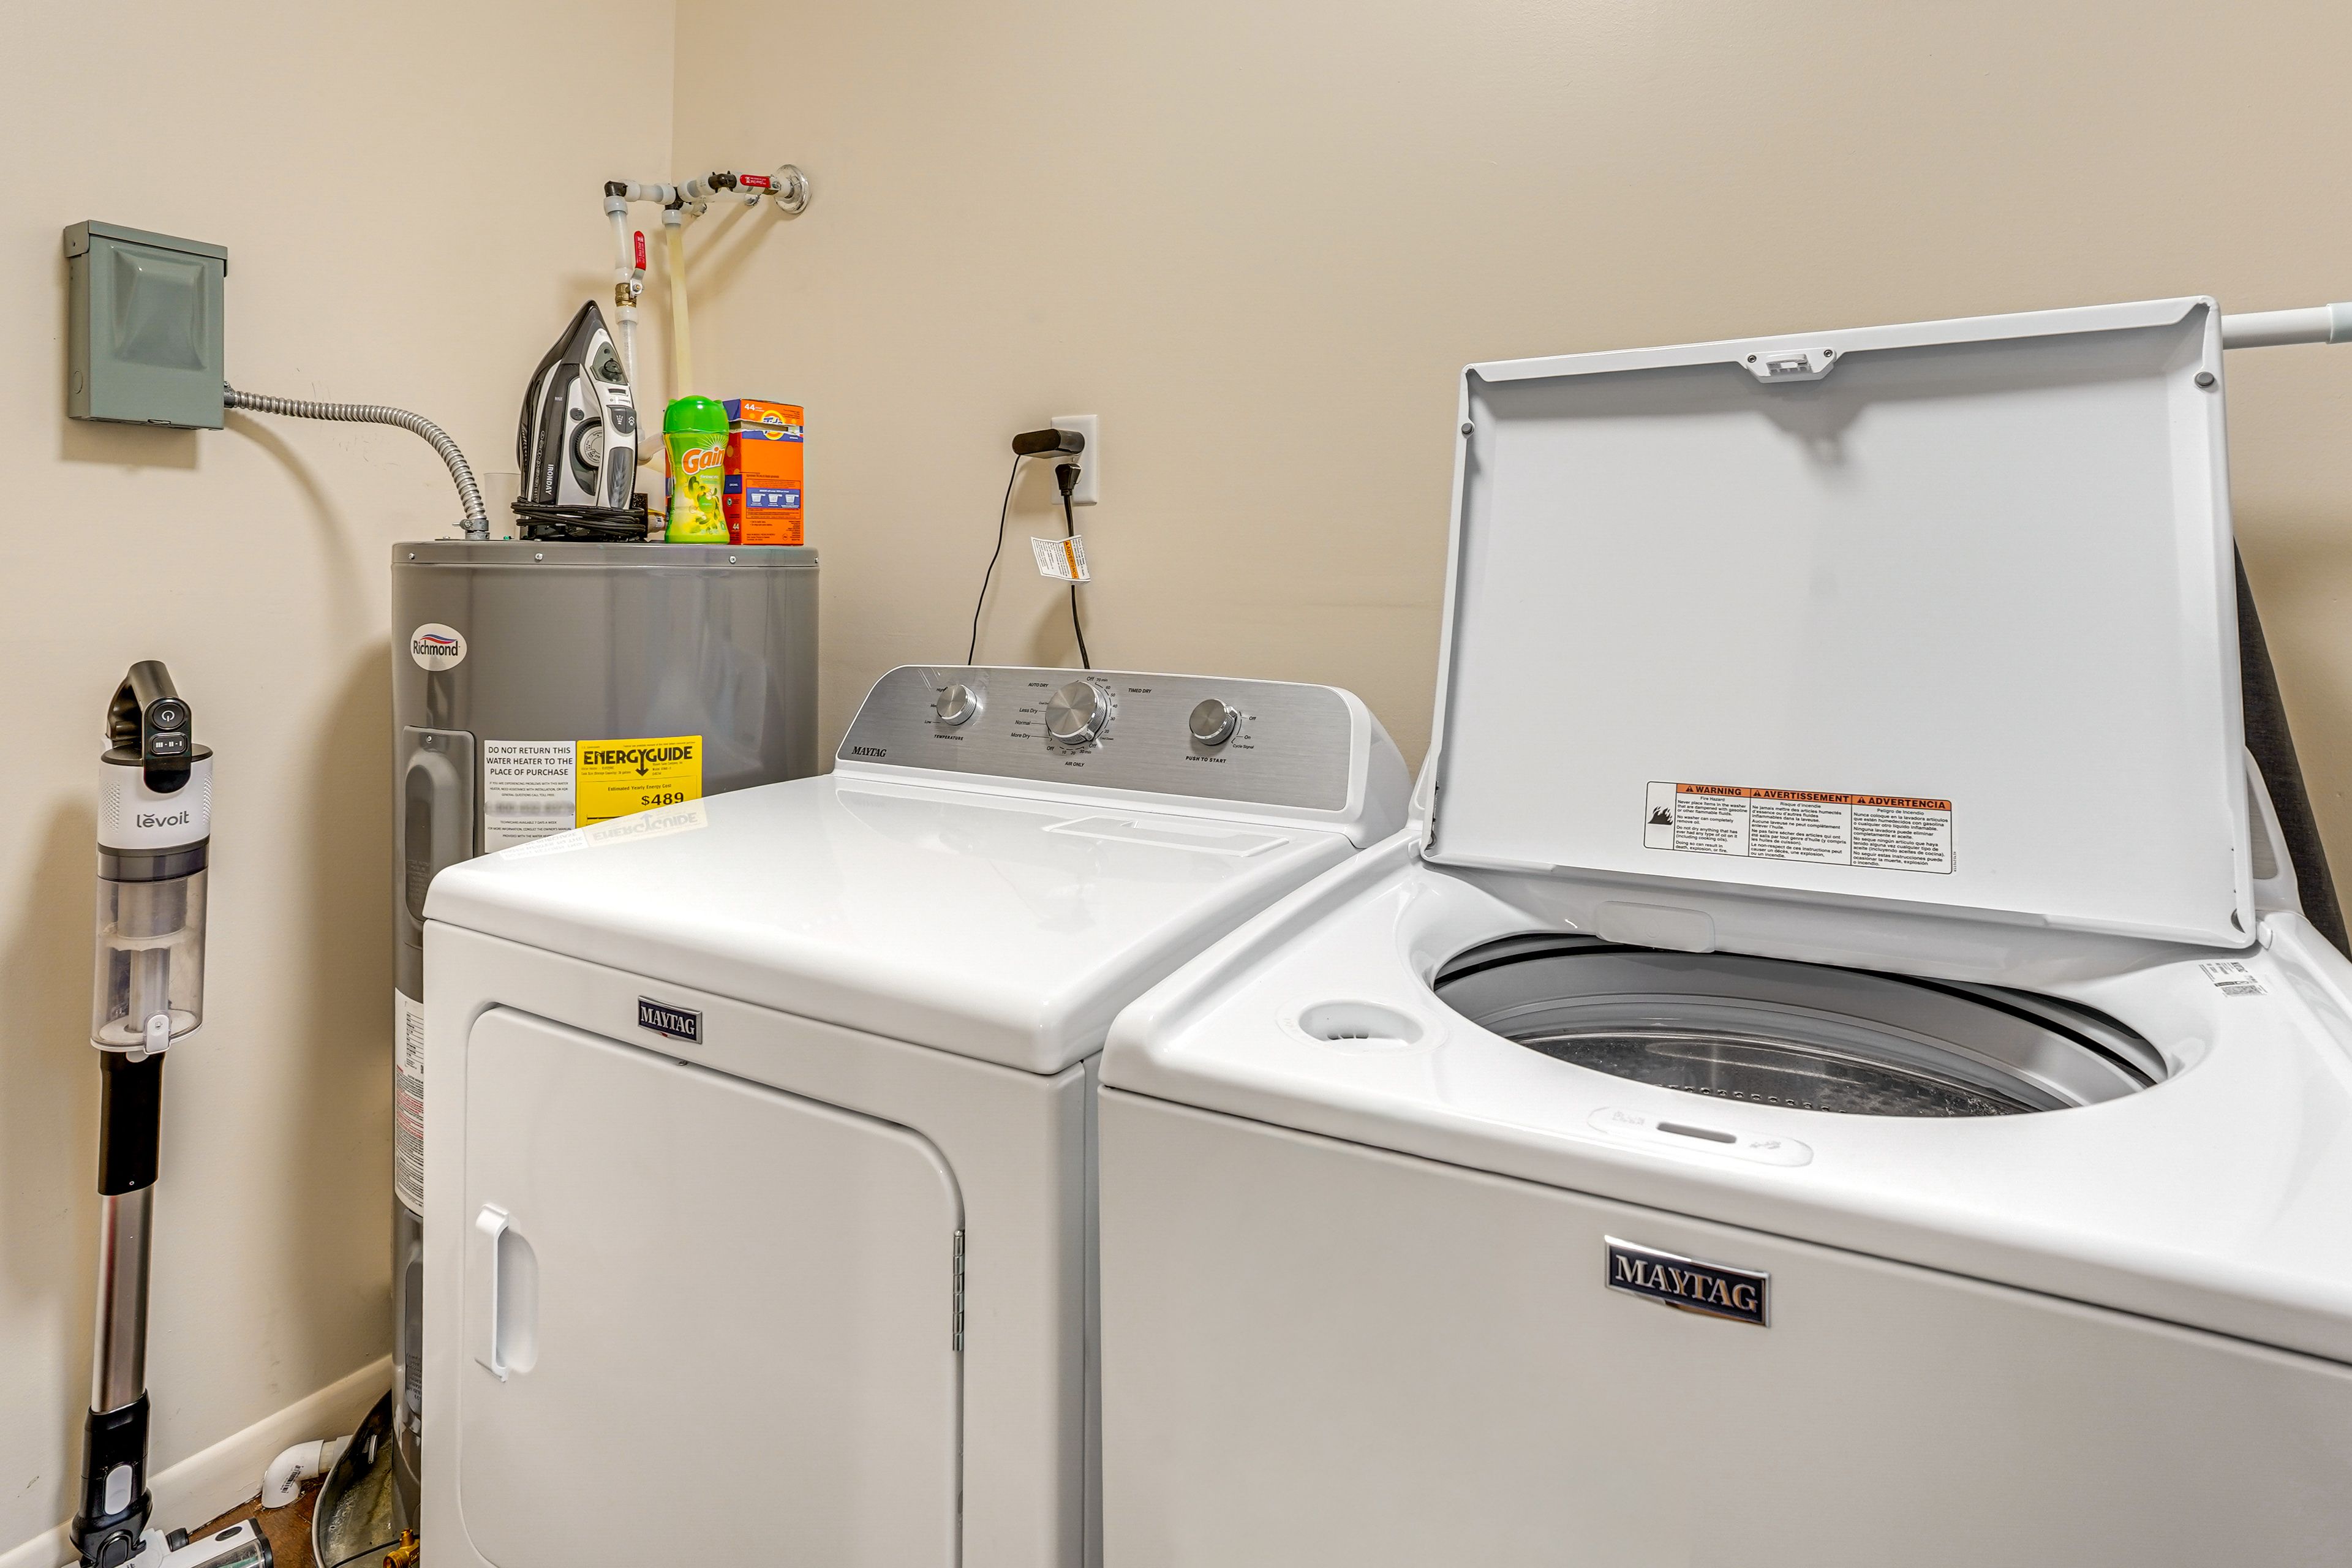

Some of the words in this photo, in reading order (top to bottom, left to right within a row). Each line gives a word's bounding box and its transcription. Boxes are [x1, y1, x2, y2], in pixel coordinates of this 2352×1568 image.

[683, 447, 725, 473] Gain
[545, 464, 554, 495] IRONDAY
[1066, 546, 1077, 578] ADVERTENCIA
[413, 640, 458, 656] Richmond
[584, 746, 692, 769] ENERGYGUIDE
[851, 746, 887, 757] MAYTAG
[641, 792, 684, 806] $489
[1696, 786, 1741, 795] WARNING
[1764, 791, 1849, 802] AVERTISSEMENT
[1869, 797, 1945, 809] ADVERTENCIA
[641, 1006, 695, 1035] MAYTAG
[1615, 1254, 1758, 1313] MAYTAG
